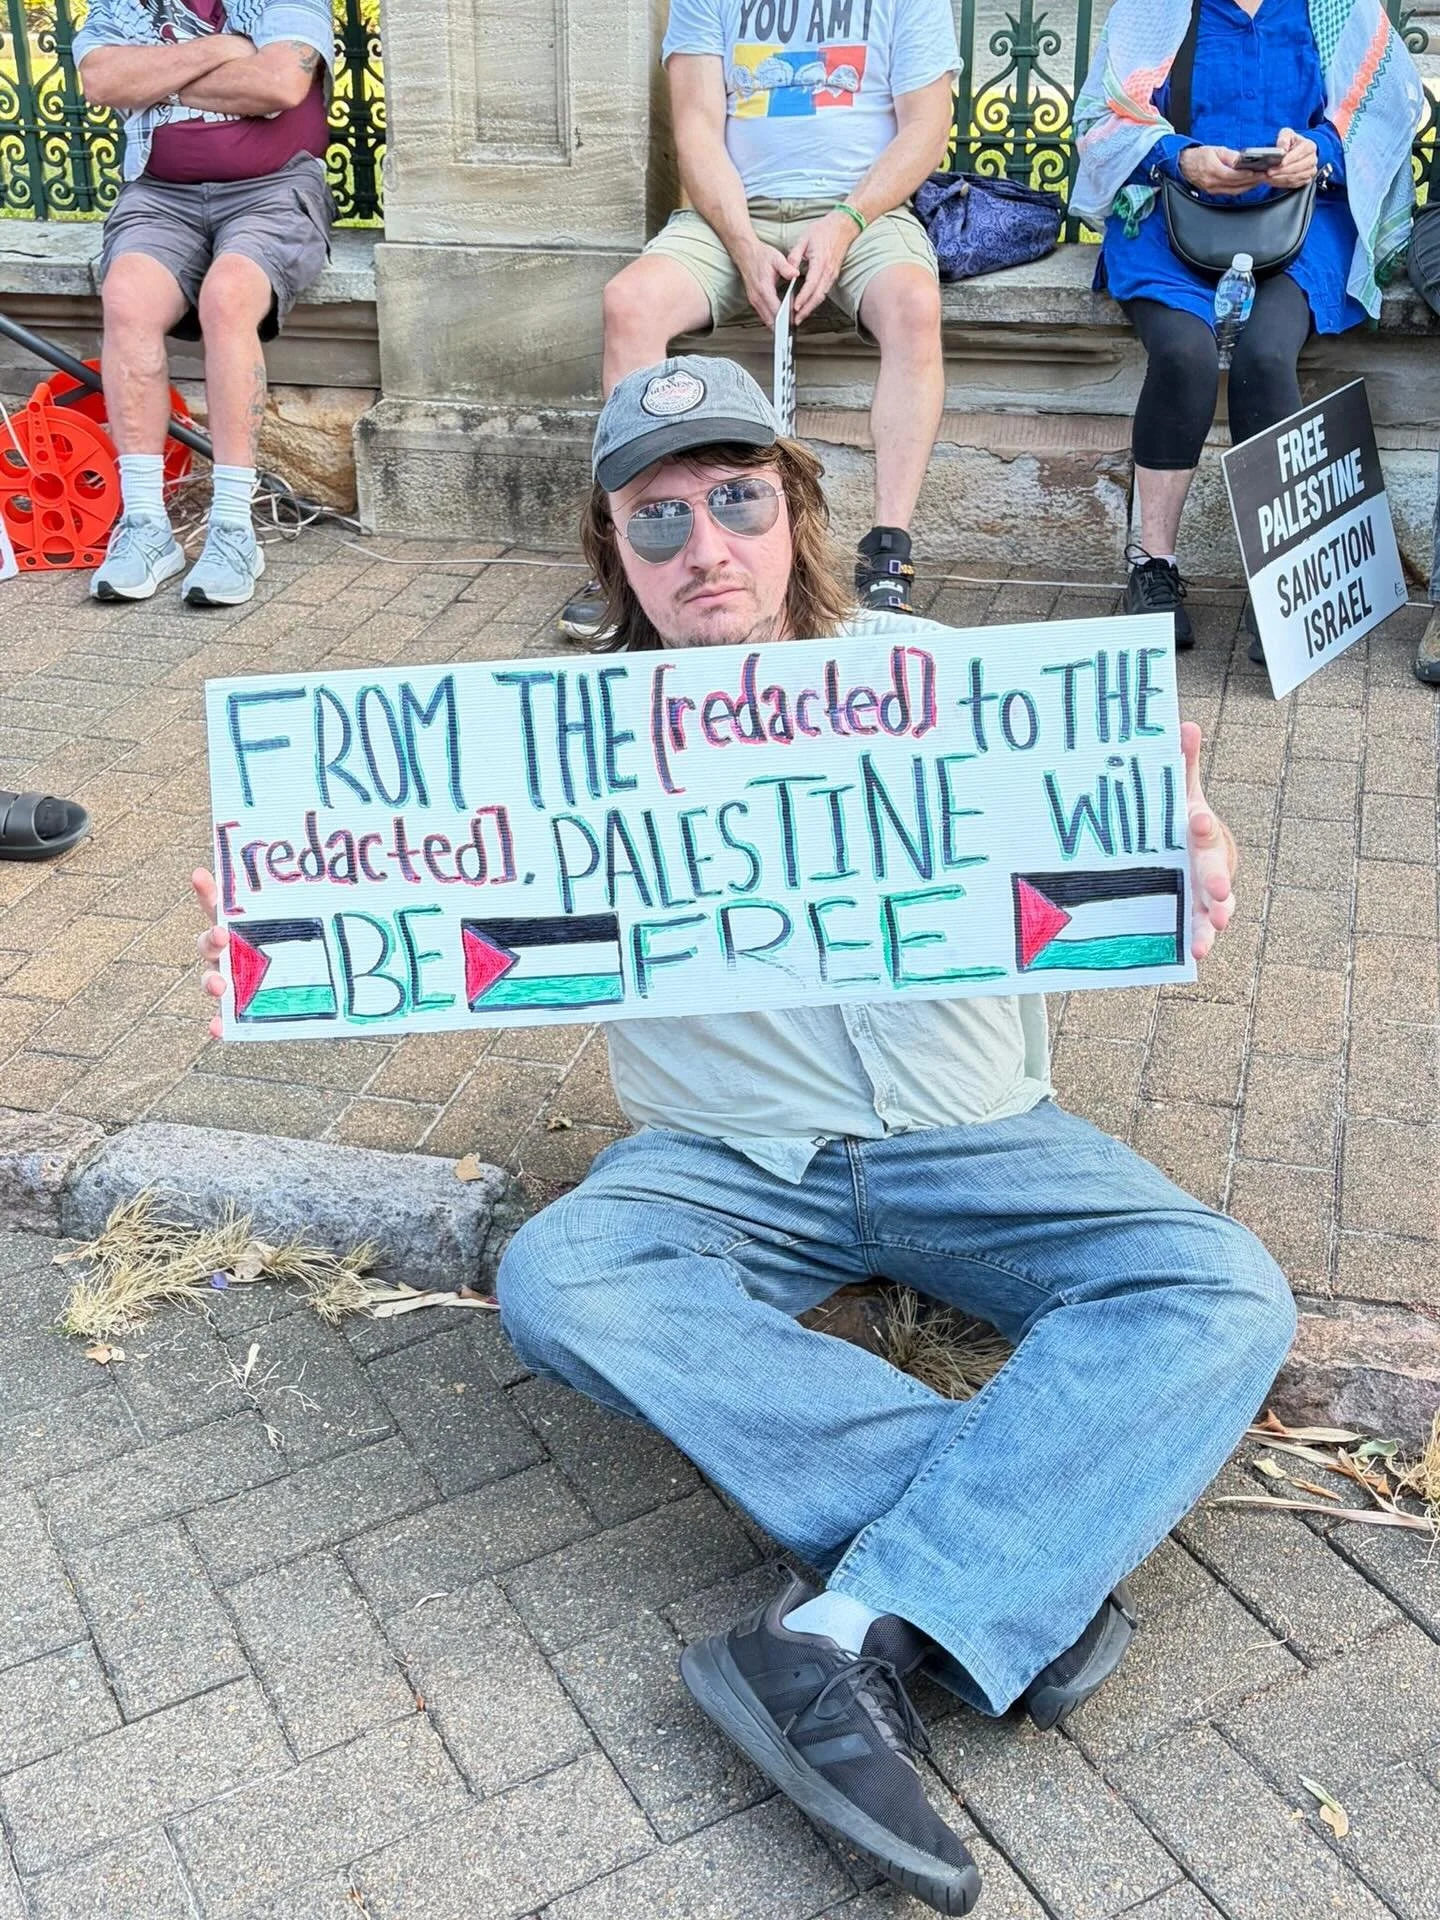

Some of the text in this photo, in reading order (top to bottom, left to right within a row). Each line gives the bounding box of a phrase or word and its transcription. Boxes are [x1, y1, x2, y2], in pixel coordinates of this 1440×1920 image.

[738, 0, 798, 43] YOU
[806, 0, 853, 43] AM
[1258, 447, 1366, 554] PALESTINE
[1276, 413, 1329, 483] FREE
[1277, 515, 1377, 619] SANCTION
[1304, 576, 1373, 658] ISRAEL
[228, 646, 1169, 811] FROM THE [redacted] to THE
[551, 751, 990, 913] PALESTINE
[333, 885, 1008, 1023] BE FREE
